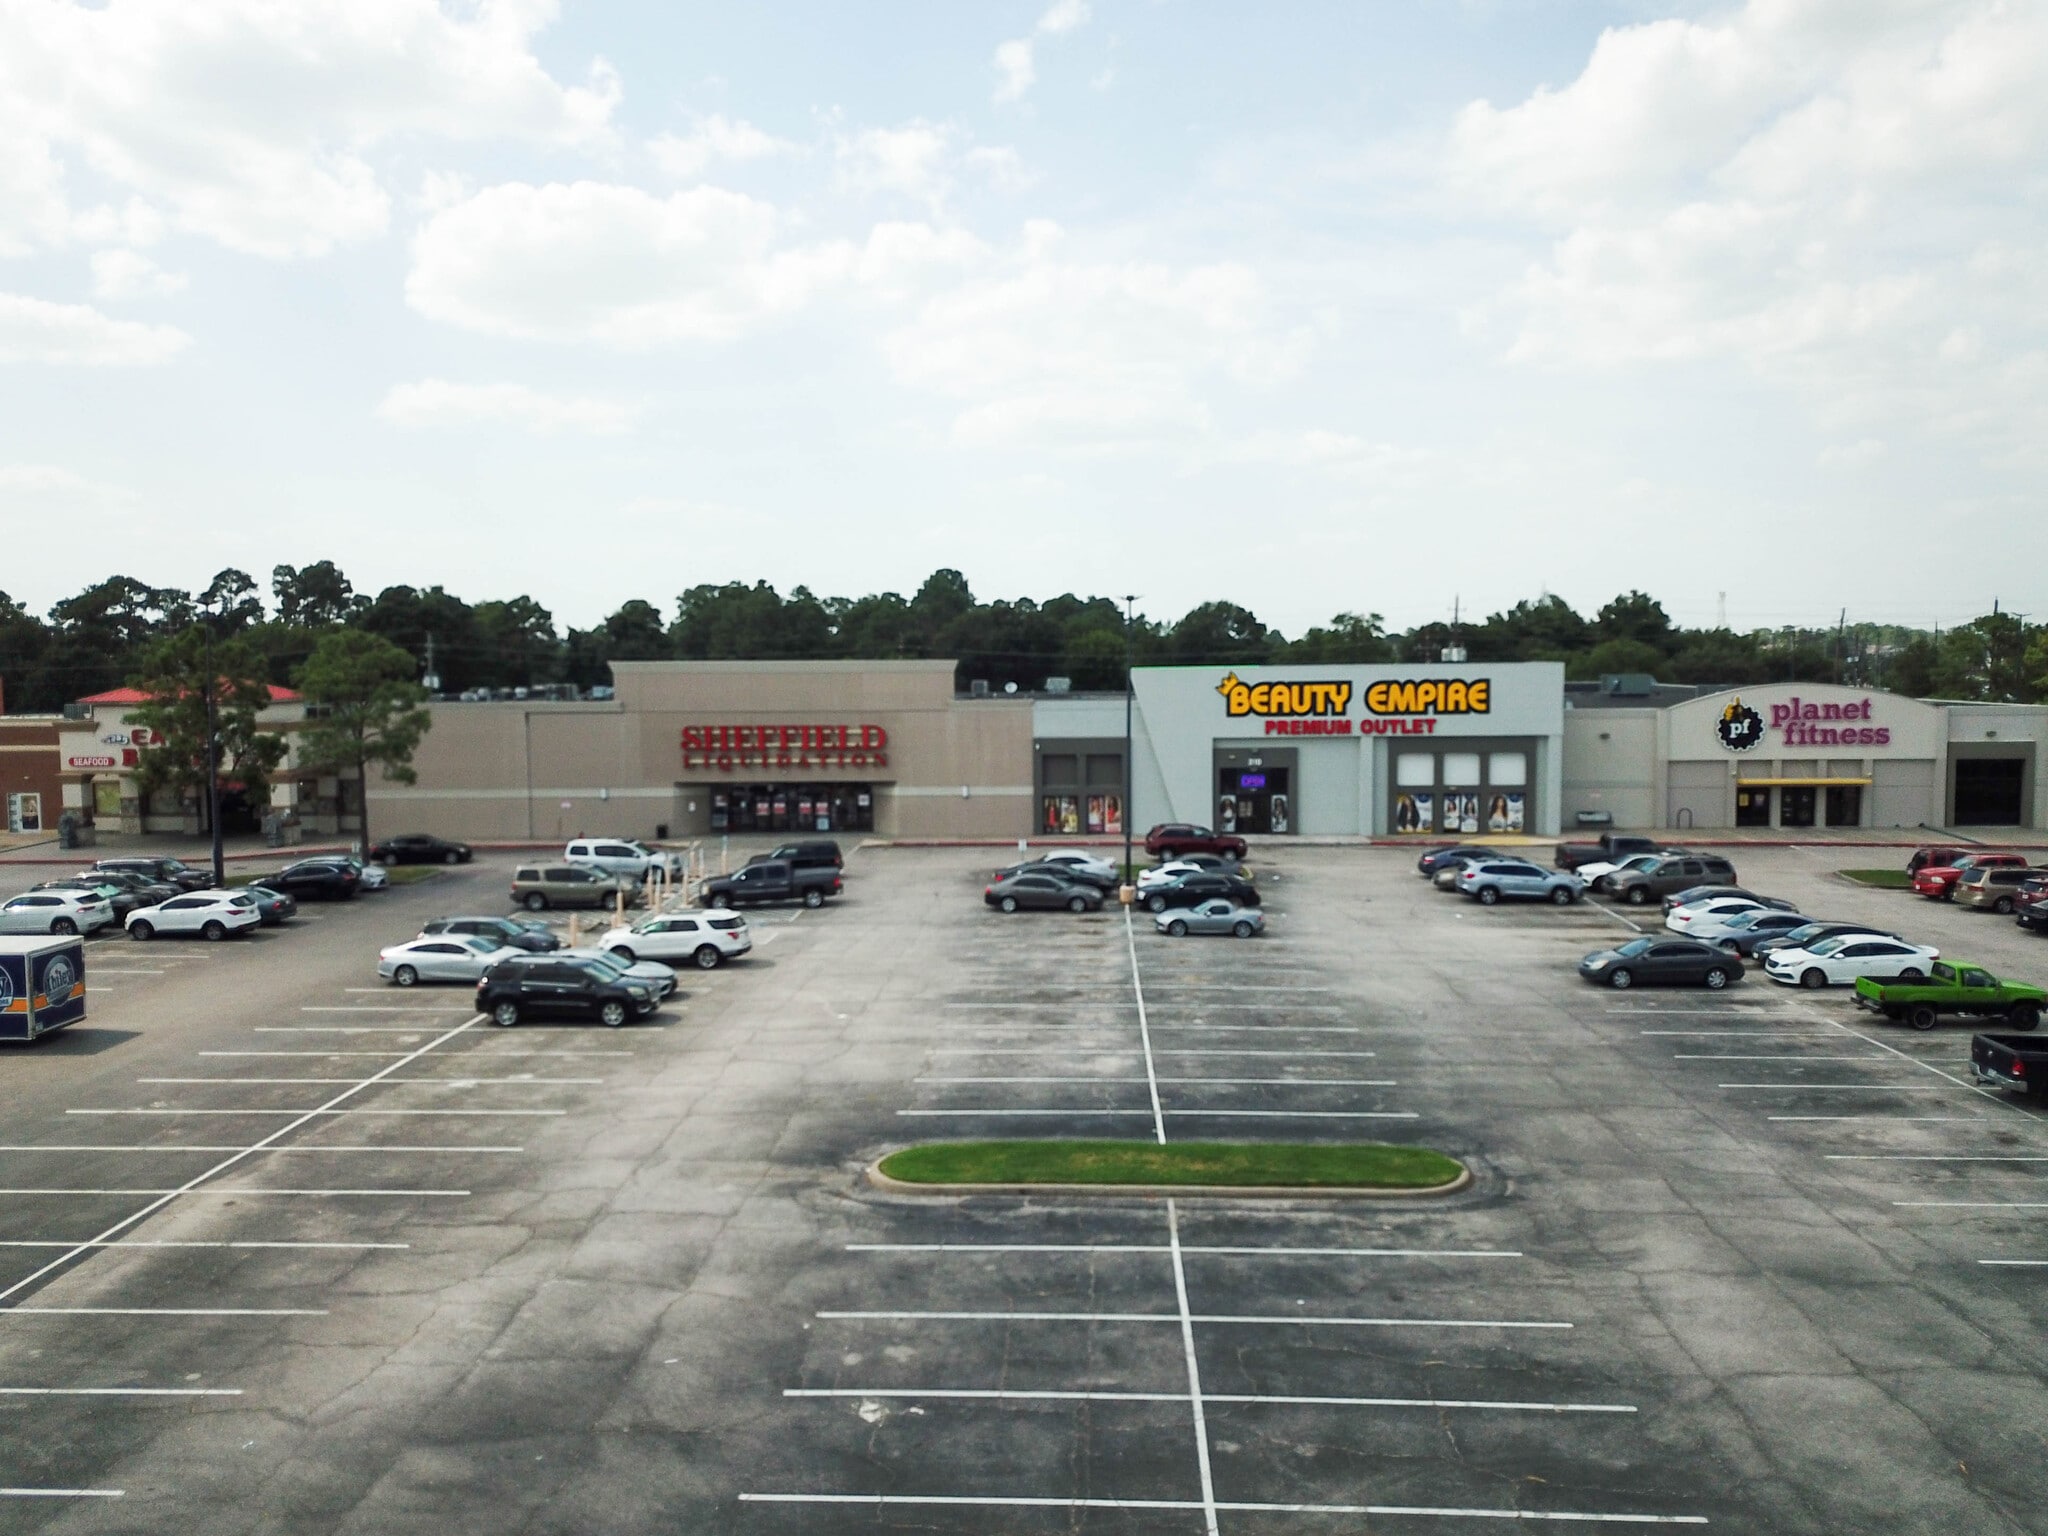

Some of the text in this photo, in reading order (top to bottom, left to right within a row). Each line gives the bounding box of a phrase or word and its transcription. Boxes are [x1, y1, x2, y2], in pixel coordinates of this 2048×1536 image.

[1226, 678, 1490, 716] BEAUTY EMPIRE
[1771, 697, 1873, 727] planet
[1264, 717, 1437, 735] PREMIUM OUTLET
[1729, 718, 1753, 739] pf
[1782, 722, 1891, 745] fitness
[681, 724, 888, 751] SHEFFIELD
[73, 757, 110, 766] SEAFOOD
[683, 753, 888, 772] LIQUIDATION
